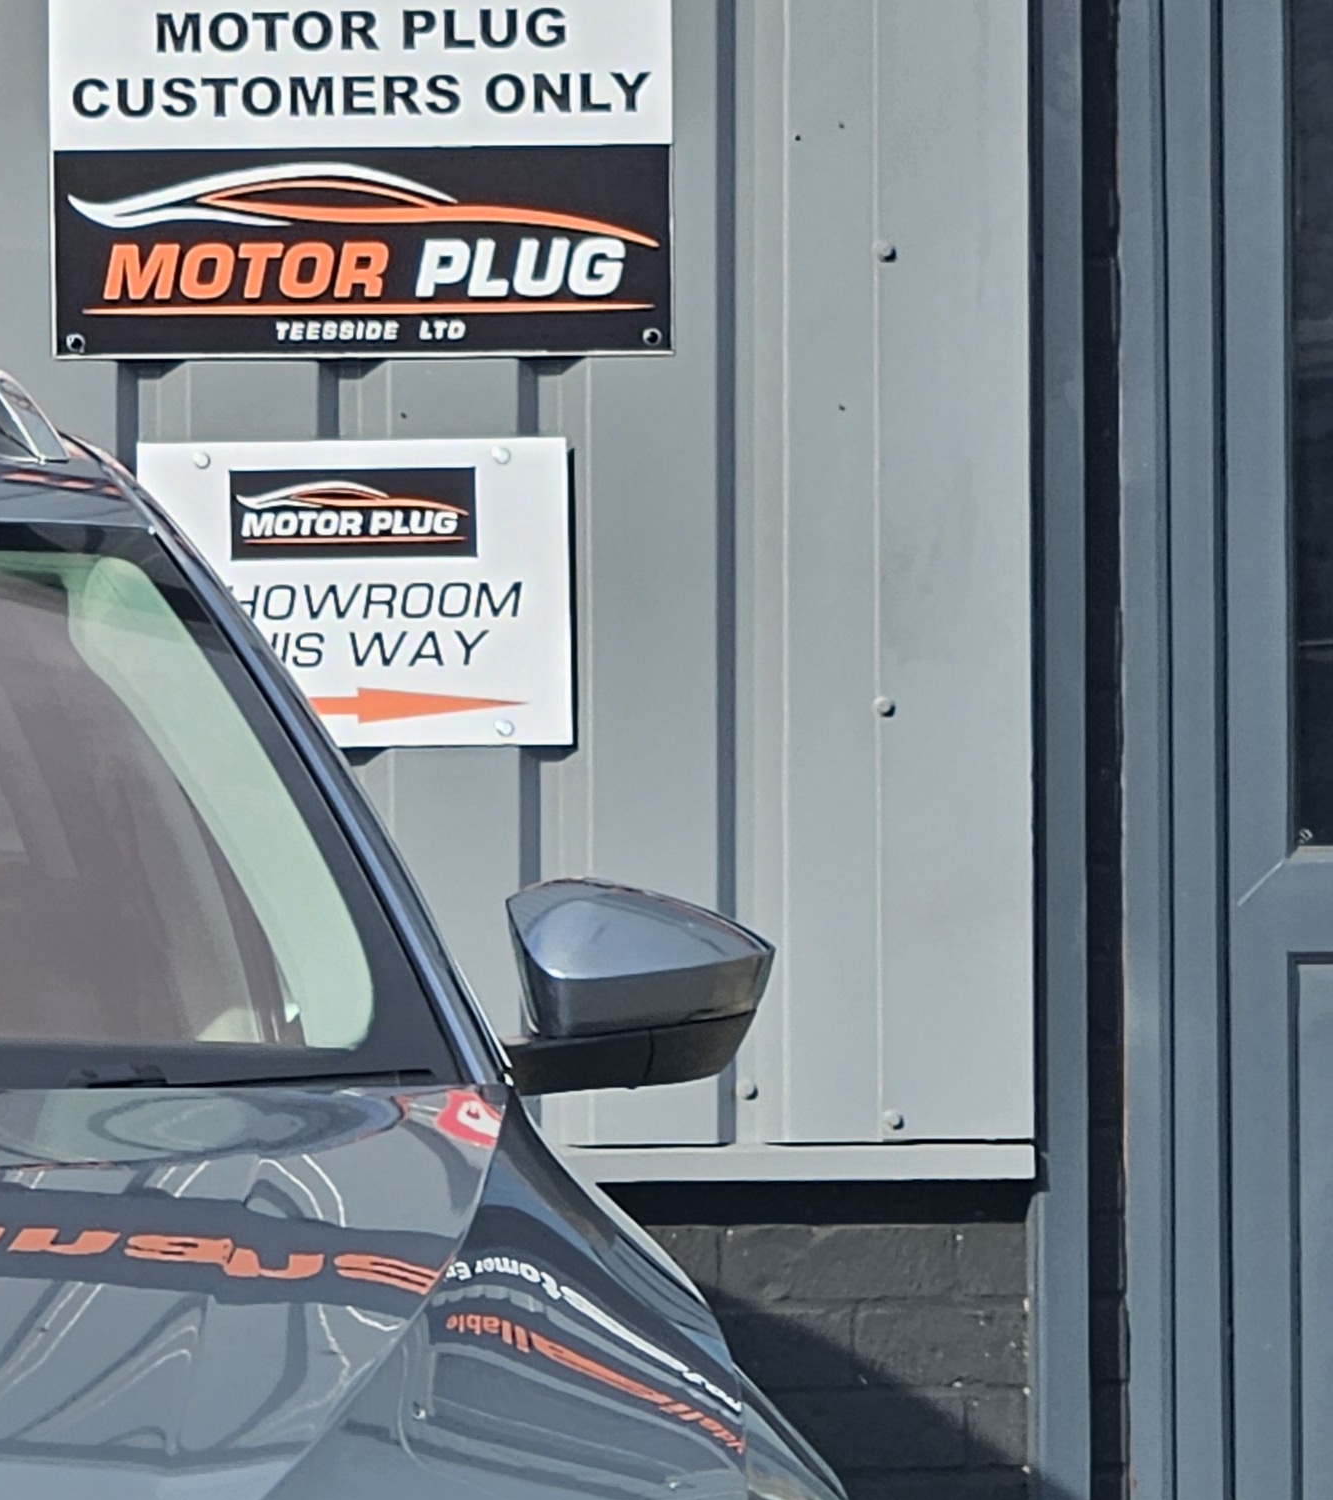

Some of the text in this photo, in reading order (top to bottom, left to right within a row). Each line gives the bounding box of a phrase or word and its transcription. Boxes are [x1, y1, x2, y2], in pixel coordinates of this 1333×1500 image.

[156, 7, 566, 53] MOTOR PLUG
[72, 71, 651, 118] CUSTOMERS ONLY
[103, 238, 625, 300] MOTOR PLUG
[275, 319, 466, 341] TEESSIDE LTD
[241, 510, 458, 537] MOTOR PLUG
[229, 581, 523, 620] HOWROOM
[269, 629, 490, 668] IS WAY
